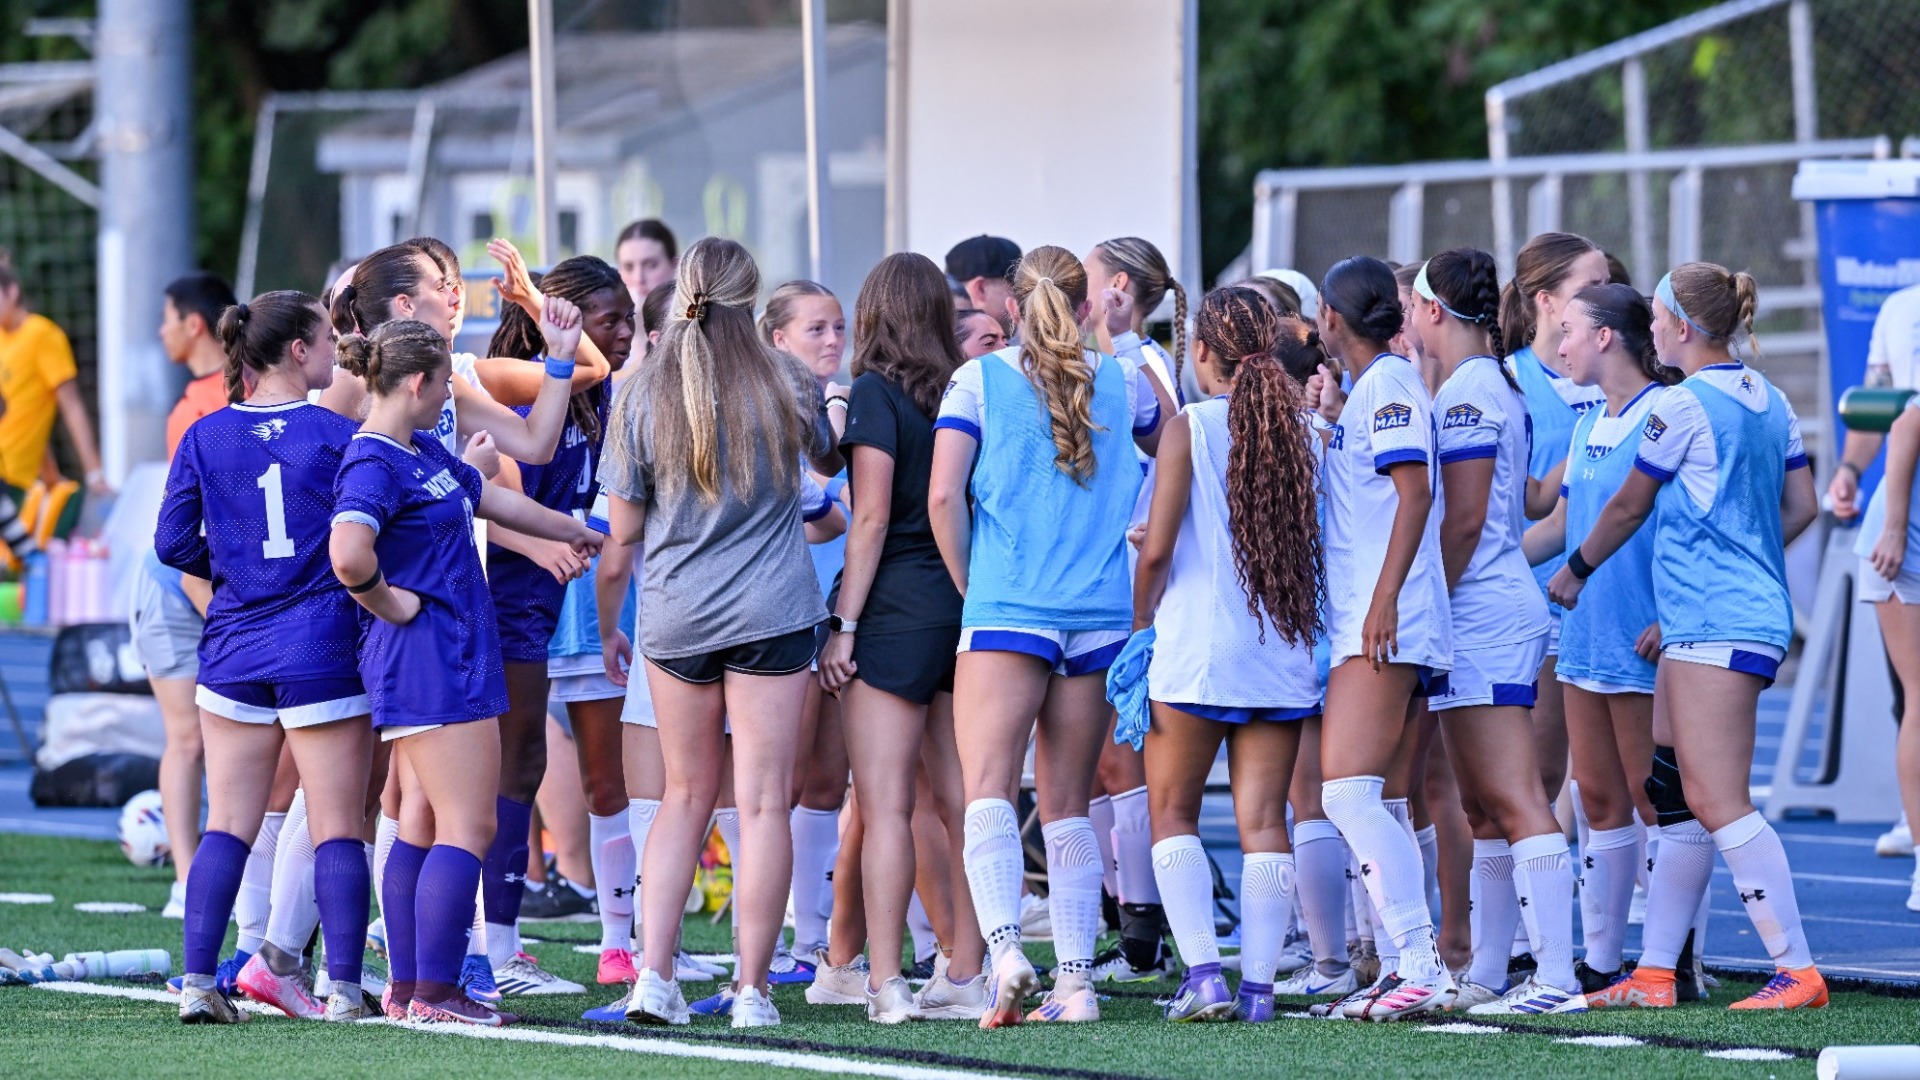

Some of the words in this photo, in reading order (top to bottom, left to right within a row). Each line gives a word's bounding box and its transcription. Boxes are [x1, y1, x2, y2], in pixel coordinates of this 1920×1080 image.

[1375, 414, 1409, 429] MAC
[1444, 415, 1478, 428] MAC
[1644, 425, 1661, 440] AC
[257, 463, 295, 559] 1
